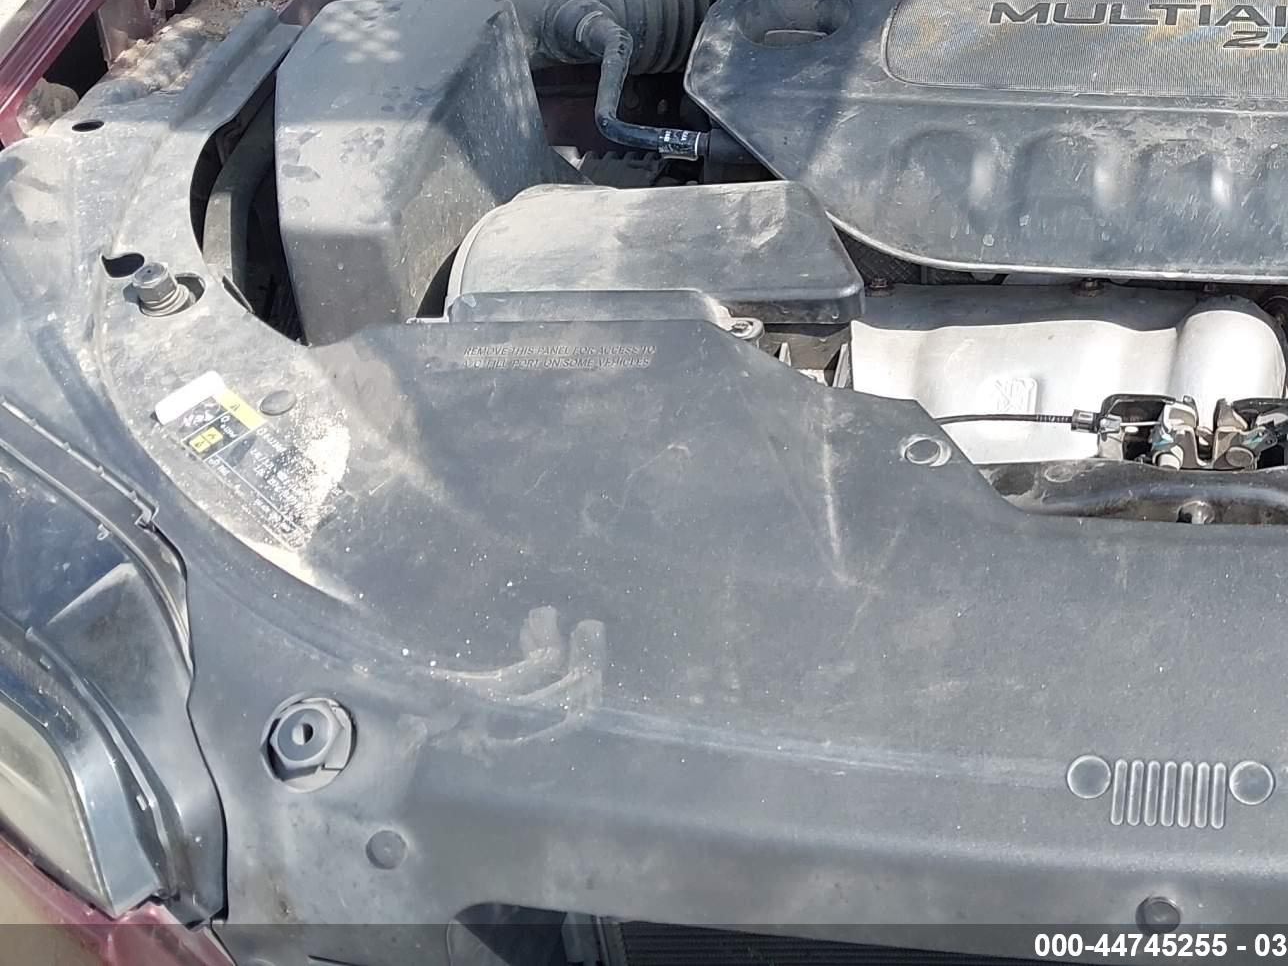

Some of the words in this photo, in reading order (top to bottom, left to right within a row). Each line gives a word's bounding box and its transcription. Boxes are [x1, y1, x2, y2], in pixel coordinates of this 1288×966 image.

[464, 346, 507, 356] REMOVE
[510, 346, 534, 356] THIS
[536, 346, 570, 356] PANEL
[572, 346, 595, 356] FOR
[597, 346, 641, 356] ACCESS
[511, 358, 541, 369] PORT
[543, 358, 562, 369] ON
[562, 358, 593, 369] SOME
[598, 358, 651, 369] VEHICLES
